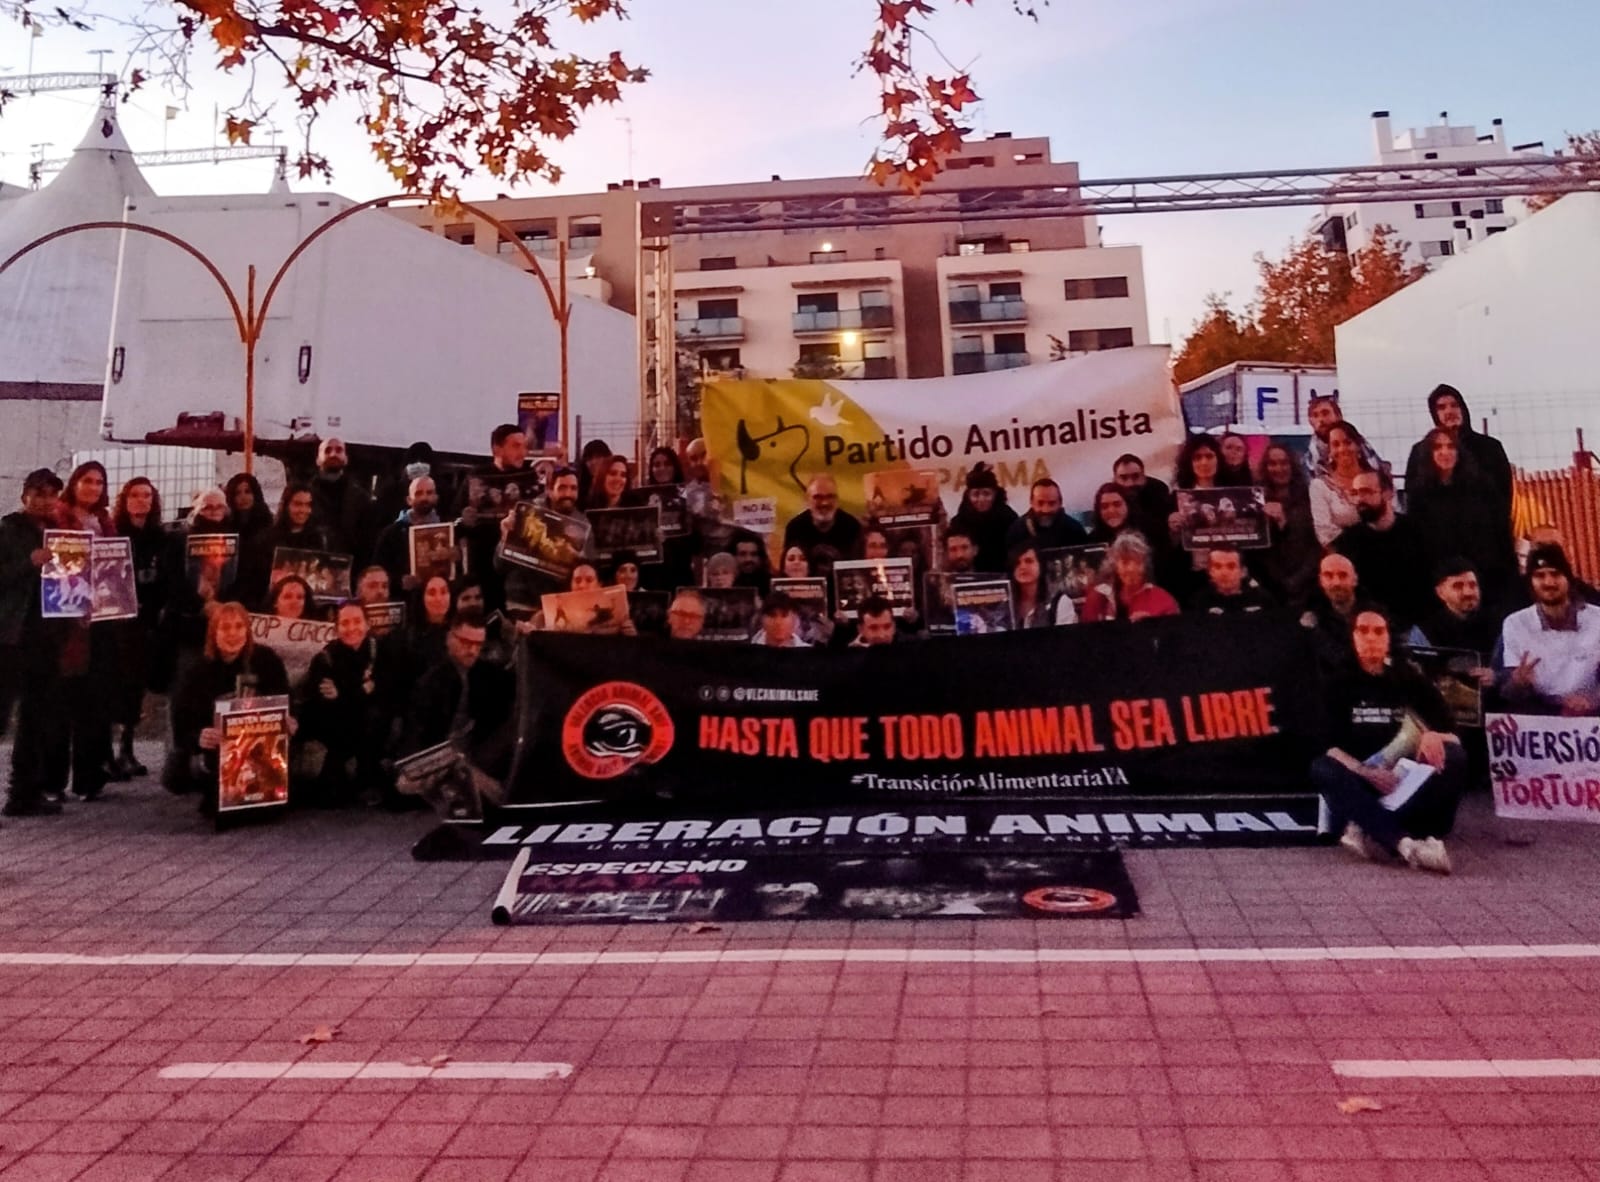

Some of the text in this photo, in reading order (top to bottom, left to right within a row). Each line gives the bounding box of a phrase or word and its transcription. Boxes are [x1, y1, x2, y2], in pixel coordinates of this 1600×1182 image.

[1257, 387, 1279, 421] F
[823, 409, 1153, 466] Partido Animalista
[938, 458, 1052, 492] PAMA
[250, 614, 281, 639] TOP
[699, 687, 1280, 763] HASTA QUE TODO ANIMAL SEA LIBRE
[1491, 725, 1600, 764] DIVERSIÓ
[851, 766, 1130, 791] #TransiciónAlimentariaYA
[1491, 759, 1518, 782] SU
[1498, 774, 1600, 812] TORTUR
[481, 811, 1318, 845] LIBERACIÓN ANIMAL
[523, 859, 749, 877] ESPECISMO
